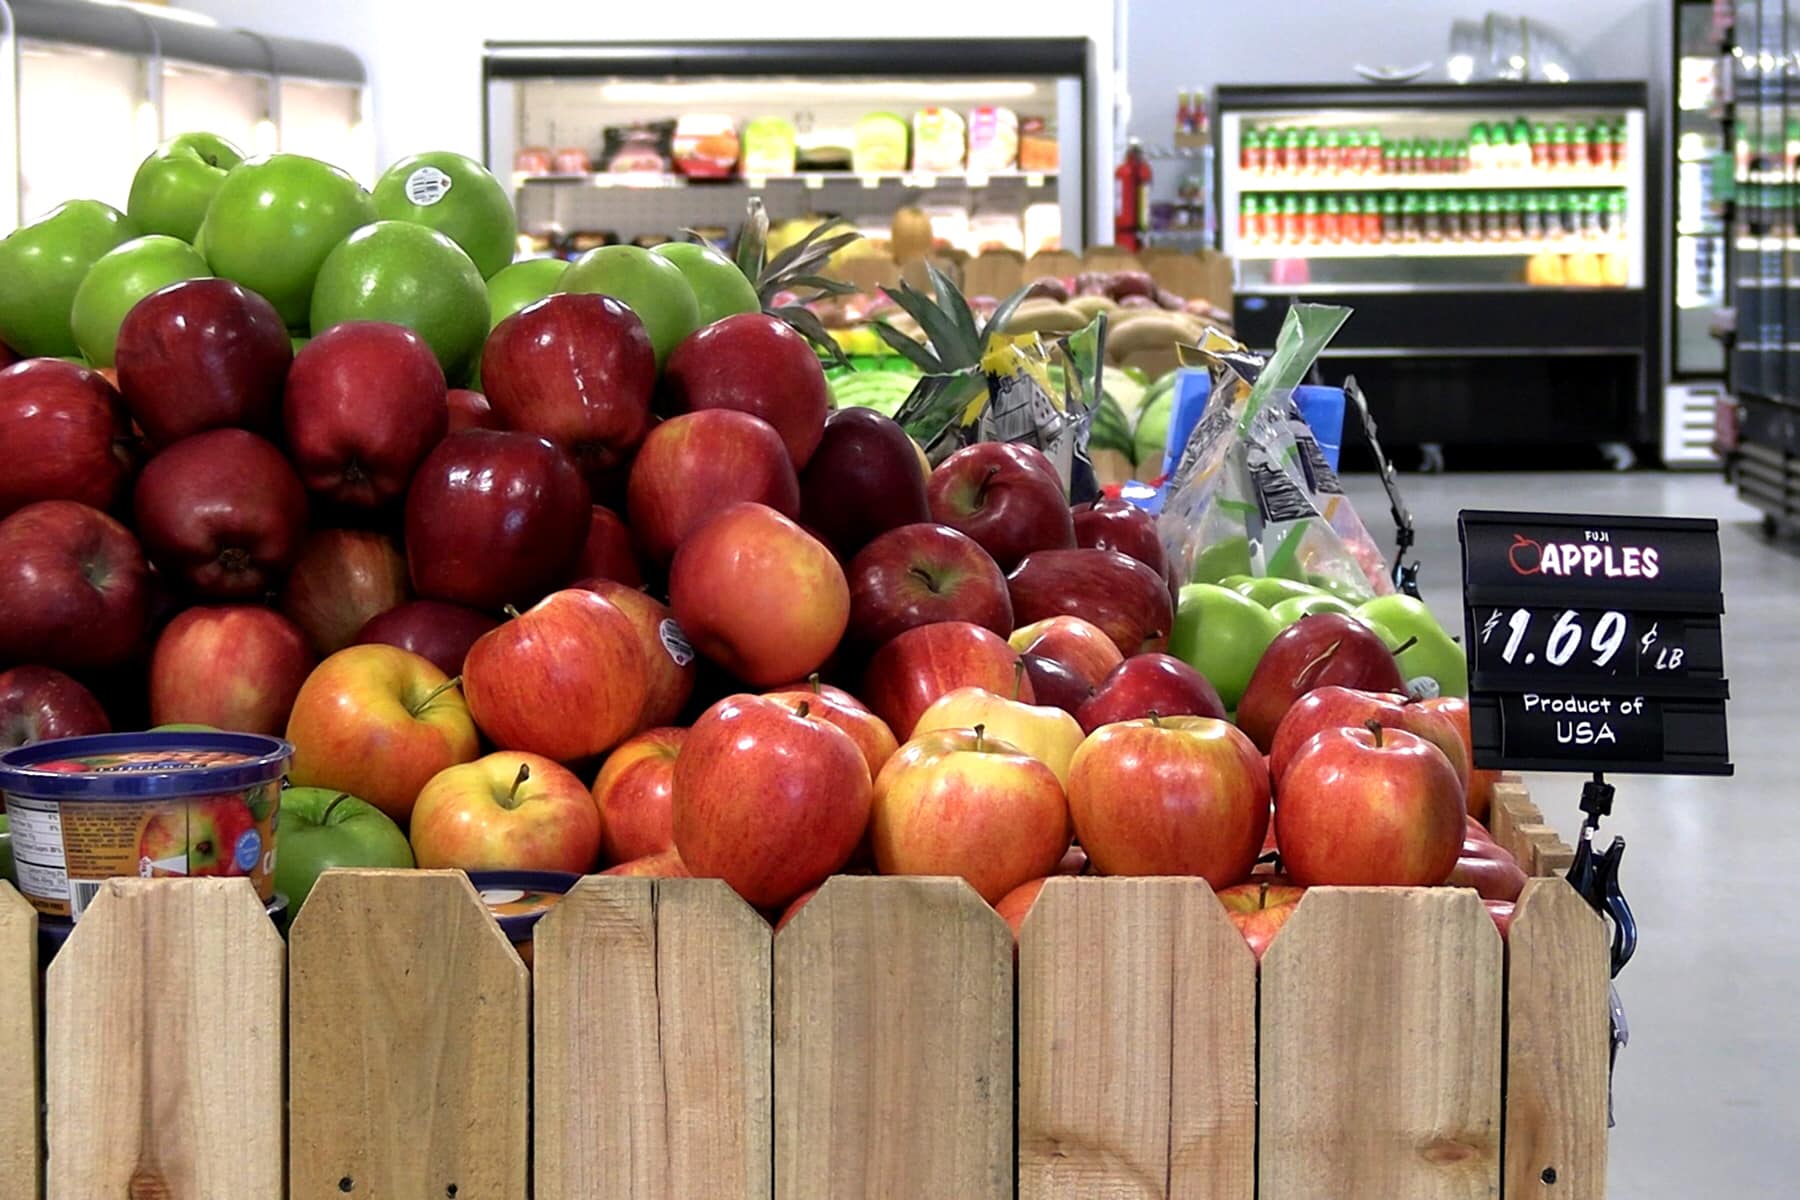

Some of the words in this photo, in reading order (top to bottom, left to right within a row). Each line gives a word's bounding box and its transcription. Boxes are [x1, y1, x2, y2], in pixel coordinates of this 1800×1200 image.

[1584, 530, 1610, 543] FUJI
[1540, 543, 1659, 578] APPLES
[1654, 647, 1684, 670] LB
[1523, 693, 1611, 714] Product
[1619, 696, 1644, 715] of
[1555, 720, 1617, 745] USA
